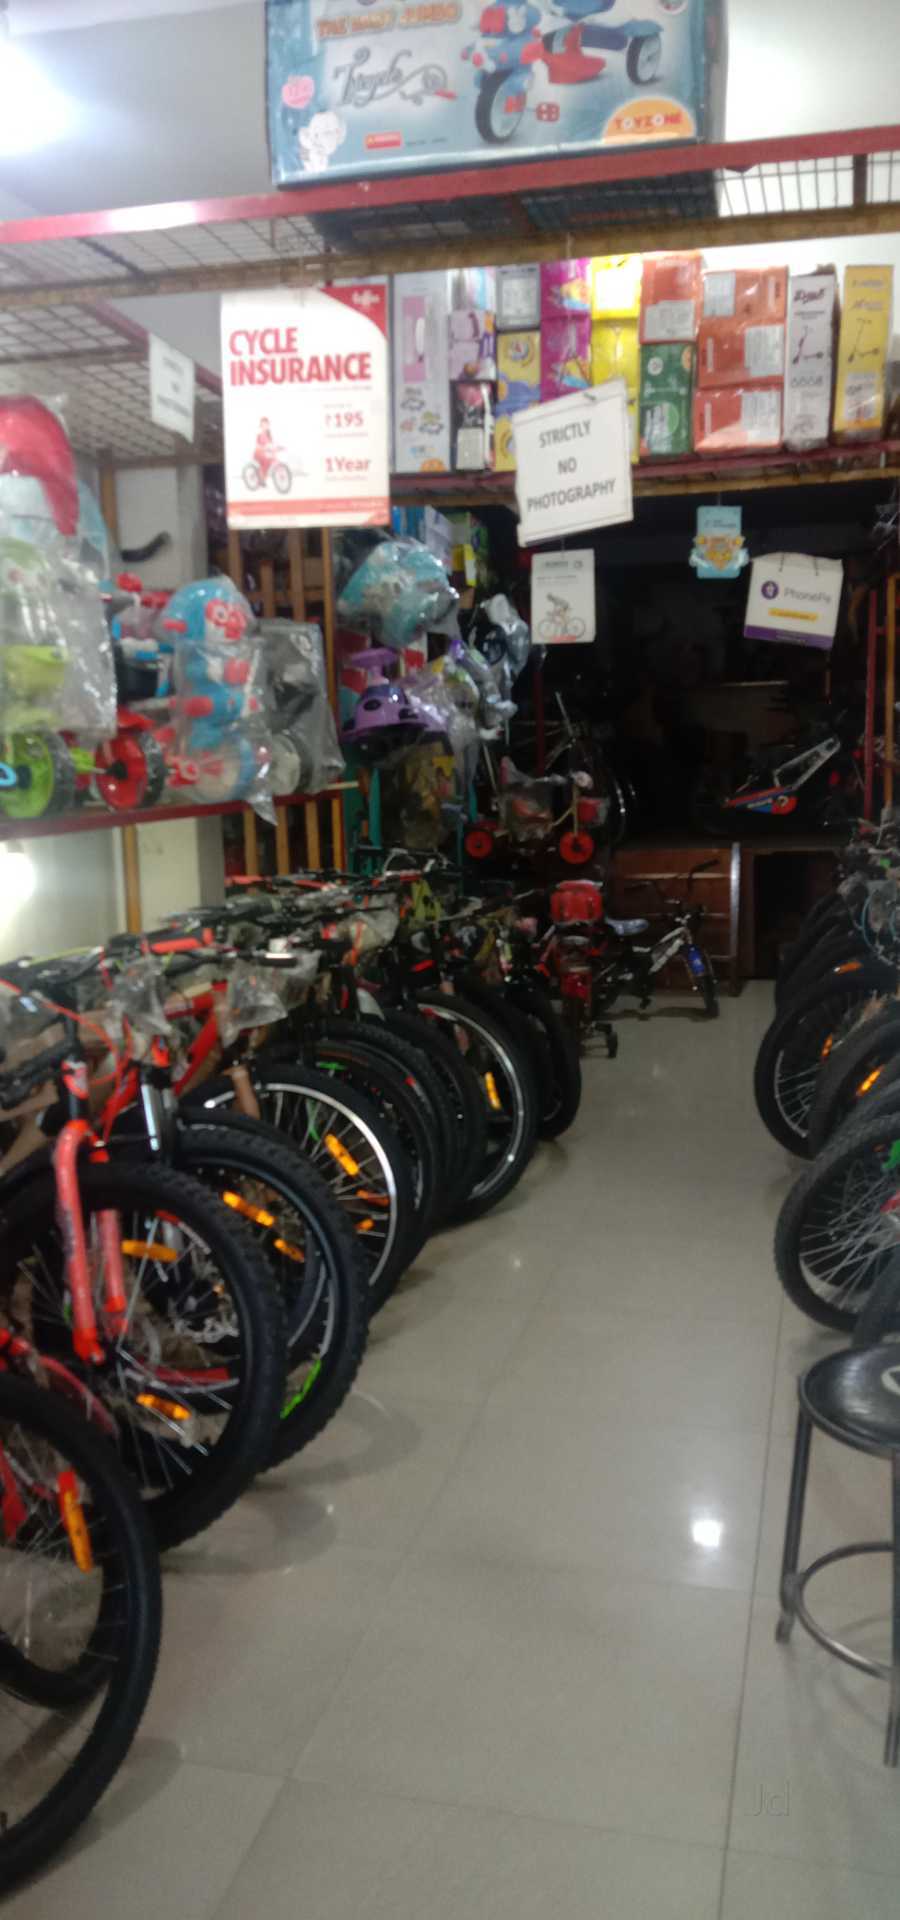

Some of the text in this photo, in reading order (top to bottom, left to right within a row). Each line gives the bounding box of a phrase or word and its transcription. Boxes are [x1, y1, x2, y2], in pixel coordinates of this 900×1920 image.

[614, 113, 683, 130] TOYZONE
[229, 327, 298, 356] CYCLE
[230, 351, 372, 386] INSURANCE
[539, 419, 592, 448] STRICTLY
[557, 456, 577, 474] NO
[526, 477, 617, 512] PHOTOGRAPHY
